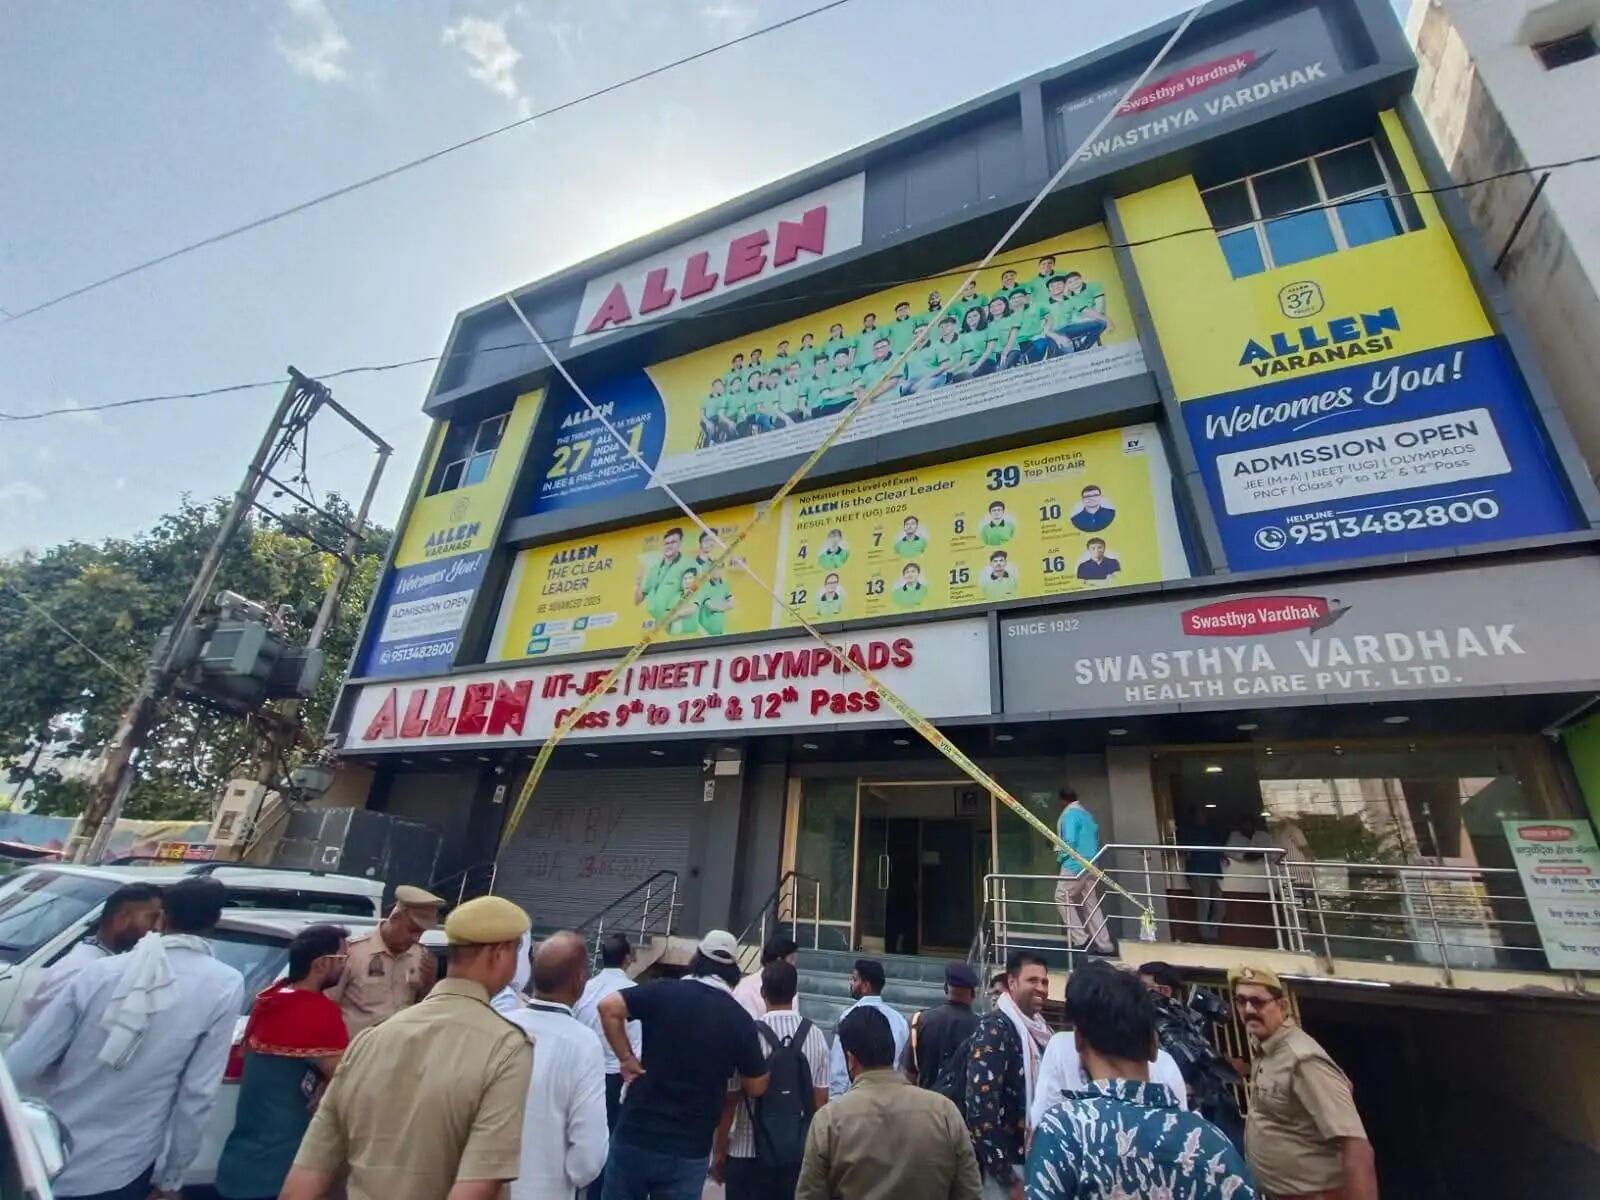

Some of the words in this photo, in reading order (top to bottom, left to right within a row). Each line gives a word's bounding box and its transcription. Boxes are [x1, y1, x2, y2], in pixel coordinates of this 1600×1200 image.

[1122, 83, 1185, 113] Swasthya
[1186, 58, 1248, 88] Vardhak
[1078, 107, 1199, 162] SWASTHYA
[1203, 61, 1328, 117] VARDHAK
[585, 205, 828, 334] ALLEN
[1287, 290, 1313, 310] 37
[1239, 306, 1401, 366] ALLEN
[1251, 335, 1394, 378] VARANASI
[1205, 385, 1354, 440] Welcomes
[1363, 350, 1464, 405] You!
[593, 443, 620, 457] INDIA
[595, 434, 613, 446] ALL
[620, 422, 645, 461] 1
[1127, 439, 1140, 448] EY
[1233, 435, 1388, 477] ADMISSION
[1394, 419, 1480, 448] OPEN
[546, 438, 593, 479] 27
[590, 454, 618, 469] RANK
[1023, 453, 1072, 468] Students
[1072, 450, 1083, 460] in
[1023, 469, 1044, 479] Top
[1045, 463, 1066, 474] 100
[1066, 460, 1086, 470] AIR
[1242, 477, 1265, 491] JEE
[1311, 464, 1345, 479] NEET
[1348, 458, 1380, 473] (UG)
[1389, 443, 1477, 467] OLYMPIADS
[552, 477, 567, 490] JEE
[575, 461, 642, 483] PRE-MEDICAL
[986, 465, 1021, 491] 39
[1253, 487, 1292, 500] PNCF
[1297, 479, 1333, 493] Class
[1355, 473, 1371, 482] to
[1435, 457, 1471, 472] Pass
[799, 496, 812, 505] No
[812, 491, 841, 504] Matter
[841, 486, 856, 497] the
[857, 481, 881, 493] Level
[881, 479, 892, 490] of
[892, 475, 919, 486] Exam
[799, 500, 839, 517] ALLEN
[840, 499, 850, 510] is
[851, 495, 872, 506] the
[874, 489, 909, 503] Clear
[909, 479, 957, 496] Leader
[835, 512, 860, 523] NEET
[863, 508, 883, 520] (UG)
[885, 503, 908, 515] 2025
[954, 518, 965, 534] 8
[1039, 504, 1062, 522] 10
[1286, 510, 1334, 525] HELPLINE
[1289, 497, 1500, 545] 9513482800
[424, 521, 482, 549] ALLEN
[872, 532, 883, 547] 7
[549, 544, 599, 566] ALLEN
[798, 546, 808, 560] 4
[1042, 556, 1065, 574] 16
[445, 553, 482, 583] You!
[547, 567, 570, 581] THE
[570, 558, 614, 577] CLEAR
[949, 567, 970, 585] 15
[541, 577, 590, 597] LEADER
[789, 589, 808, 605] 12
[865, 579, 885, 596] 13
[391, 601, 441, 619] ADMISSION
[443, 596, 469, 610] OPEN
[1191, 611, 1257, 630] Swasthya
[1258, 603, 1320, 624] Vardhak
[1007, 620, 1047, 637] SINCE
[1048, 618, 1080, 633] 1932
[391, 641, 455, 663] 9513482800
[638, 659, 708, 691] NEET
[729, 638, 915, 683] OLYMPIADS
[1074, 643, 1277, 686] SWASTHYA
[1296, 623, 1525, 668] VARDHAK
[1124, 677, 1225, 702] HEALTH
[1233, 671, 1308, 694] CARE
[1317, 668, 1382, 690] PVT.
[1393, 664, 1464, 685] LTD.
[362, 678, 534, 741] ALLEN
[554, 707, 611, 732] Cass
[616, 699, 644, 727] 9th
[647, 703, 670, 725] to
[678, 693, 722, 724] 12th
[725, 696, 743, 721] &
[750, 686, 800, 719] 12th
[810, 687, 882, 716] Pass
